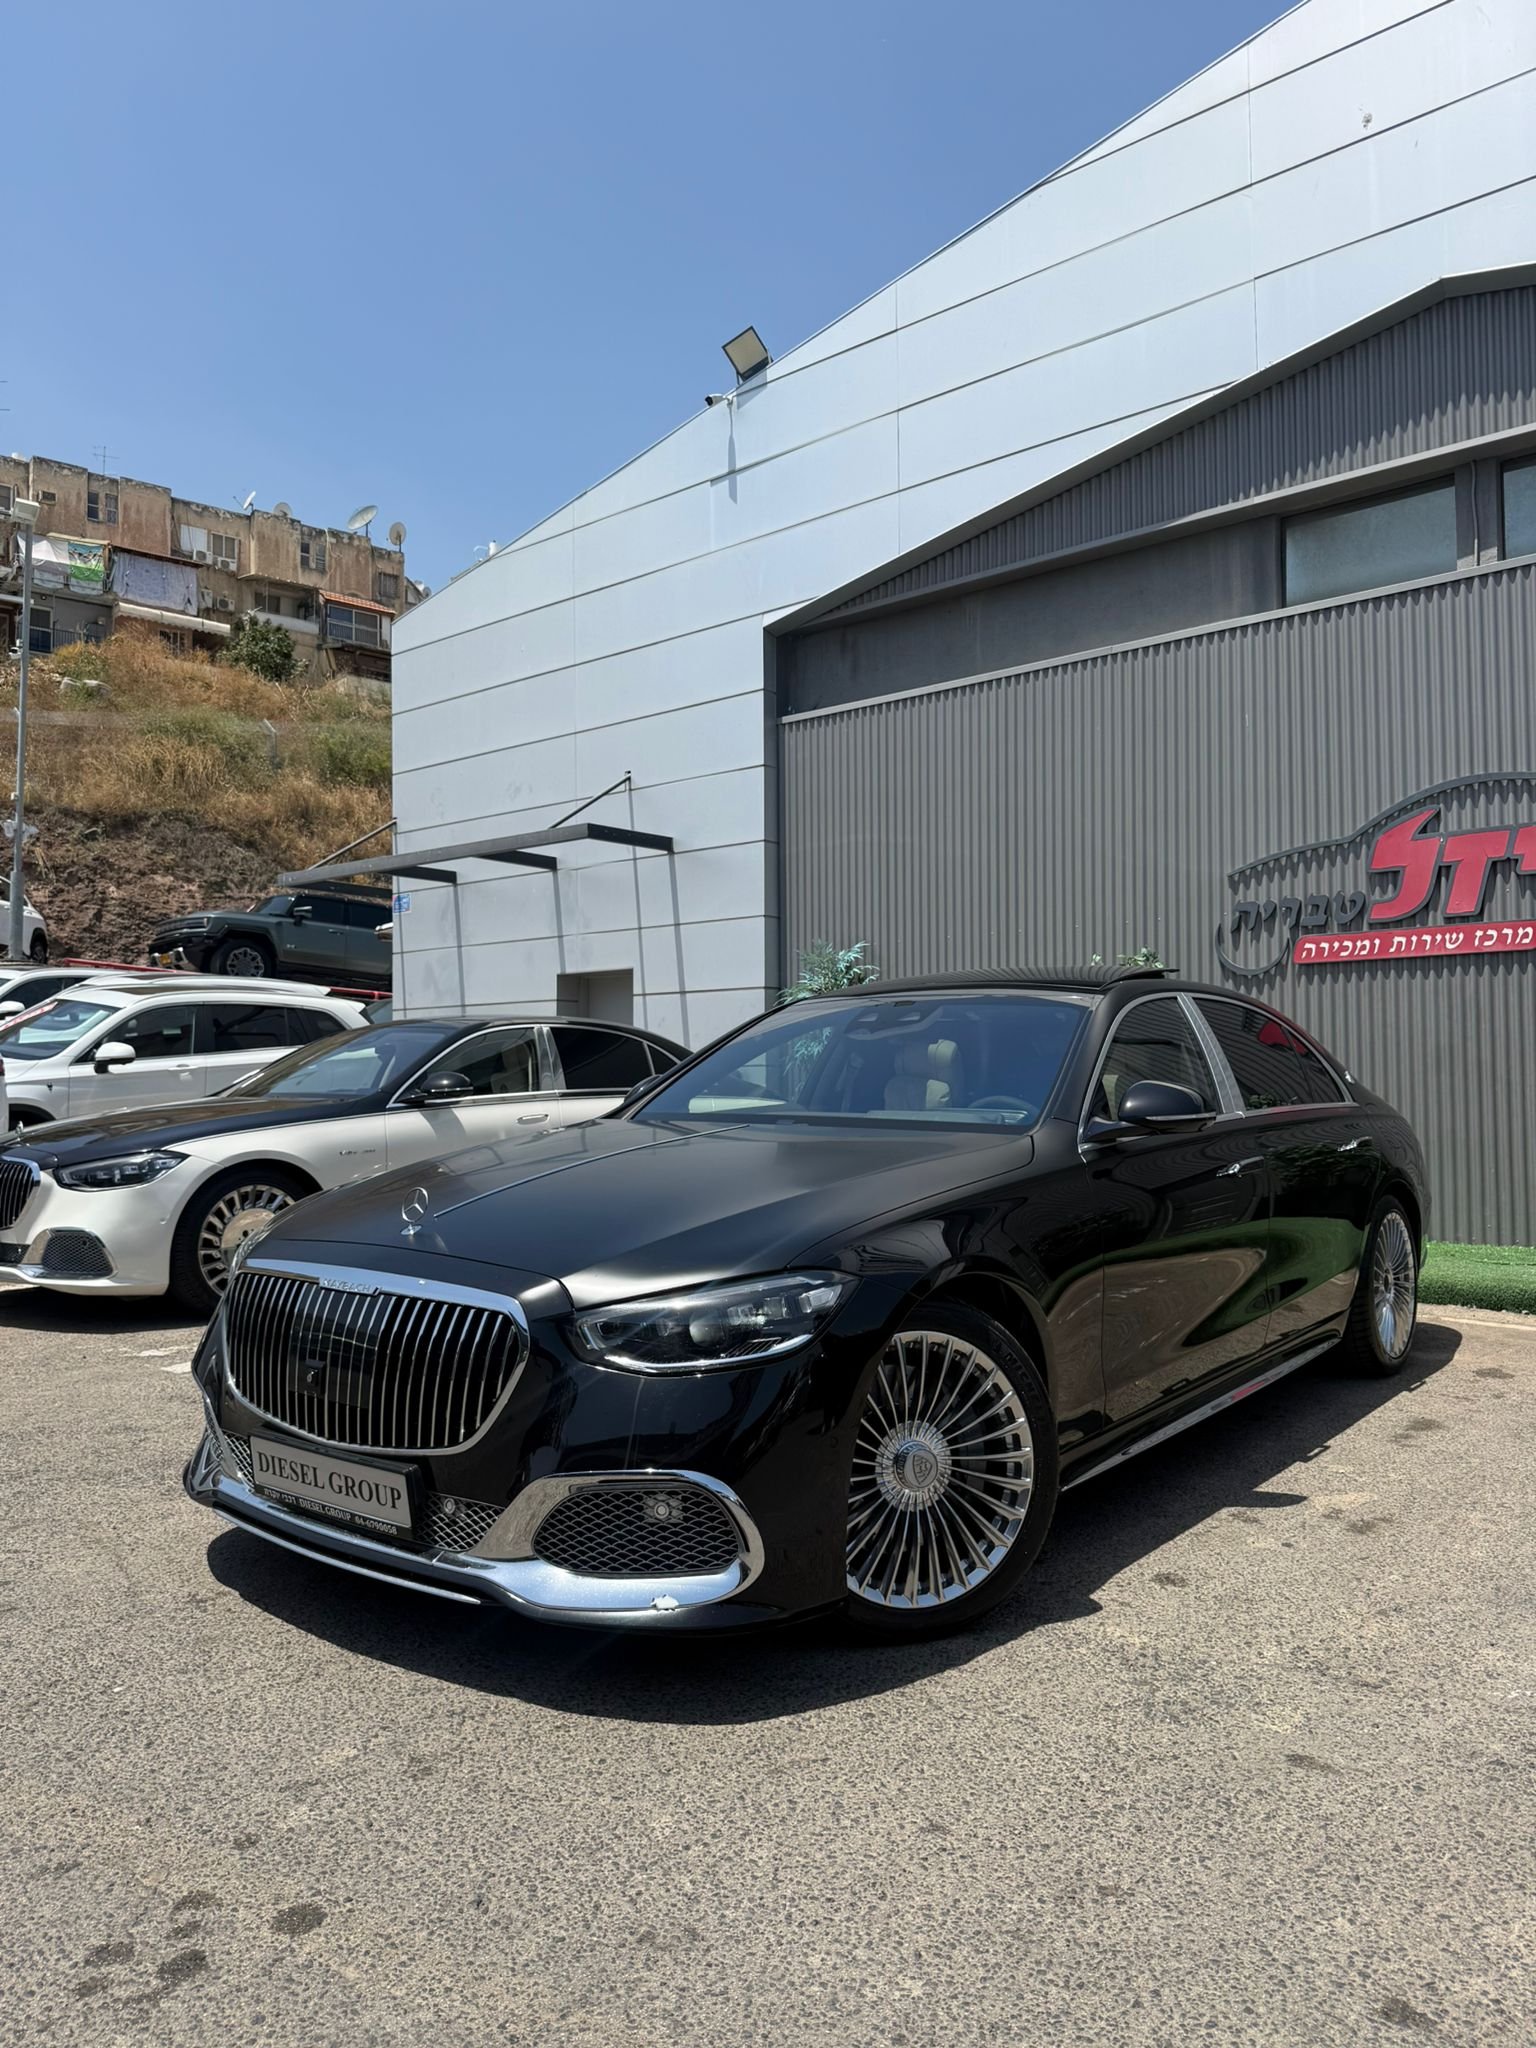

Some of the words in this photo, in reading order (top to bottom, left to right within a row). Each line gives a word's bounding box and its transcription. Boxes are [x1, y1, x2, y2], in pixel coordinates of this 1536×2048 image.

[1231, 891, 1366, 933] טבריה
[1389, 932, 1465, 953] שירות
[1473, 926, 1534, 948] מרכז
[1301, 938, 1381, 959] ומכירה
[257, 1451, 325, 1490] DIESEL
[328, 1471, 402, 1510] GROUP
[299, 1498, 325, 1514] DIESEL
[326, 1507, 352, 1521] GROUP
